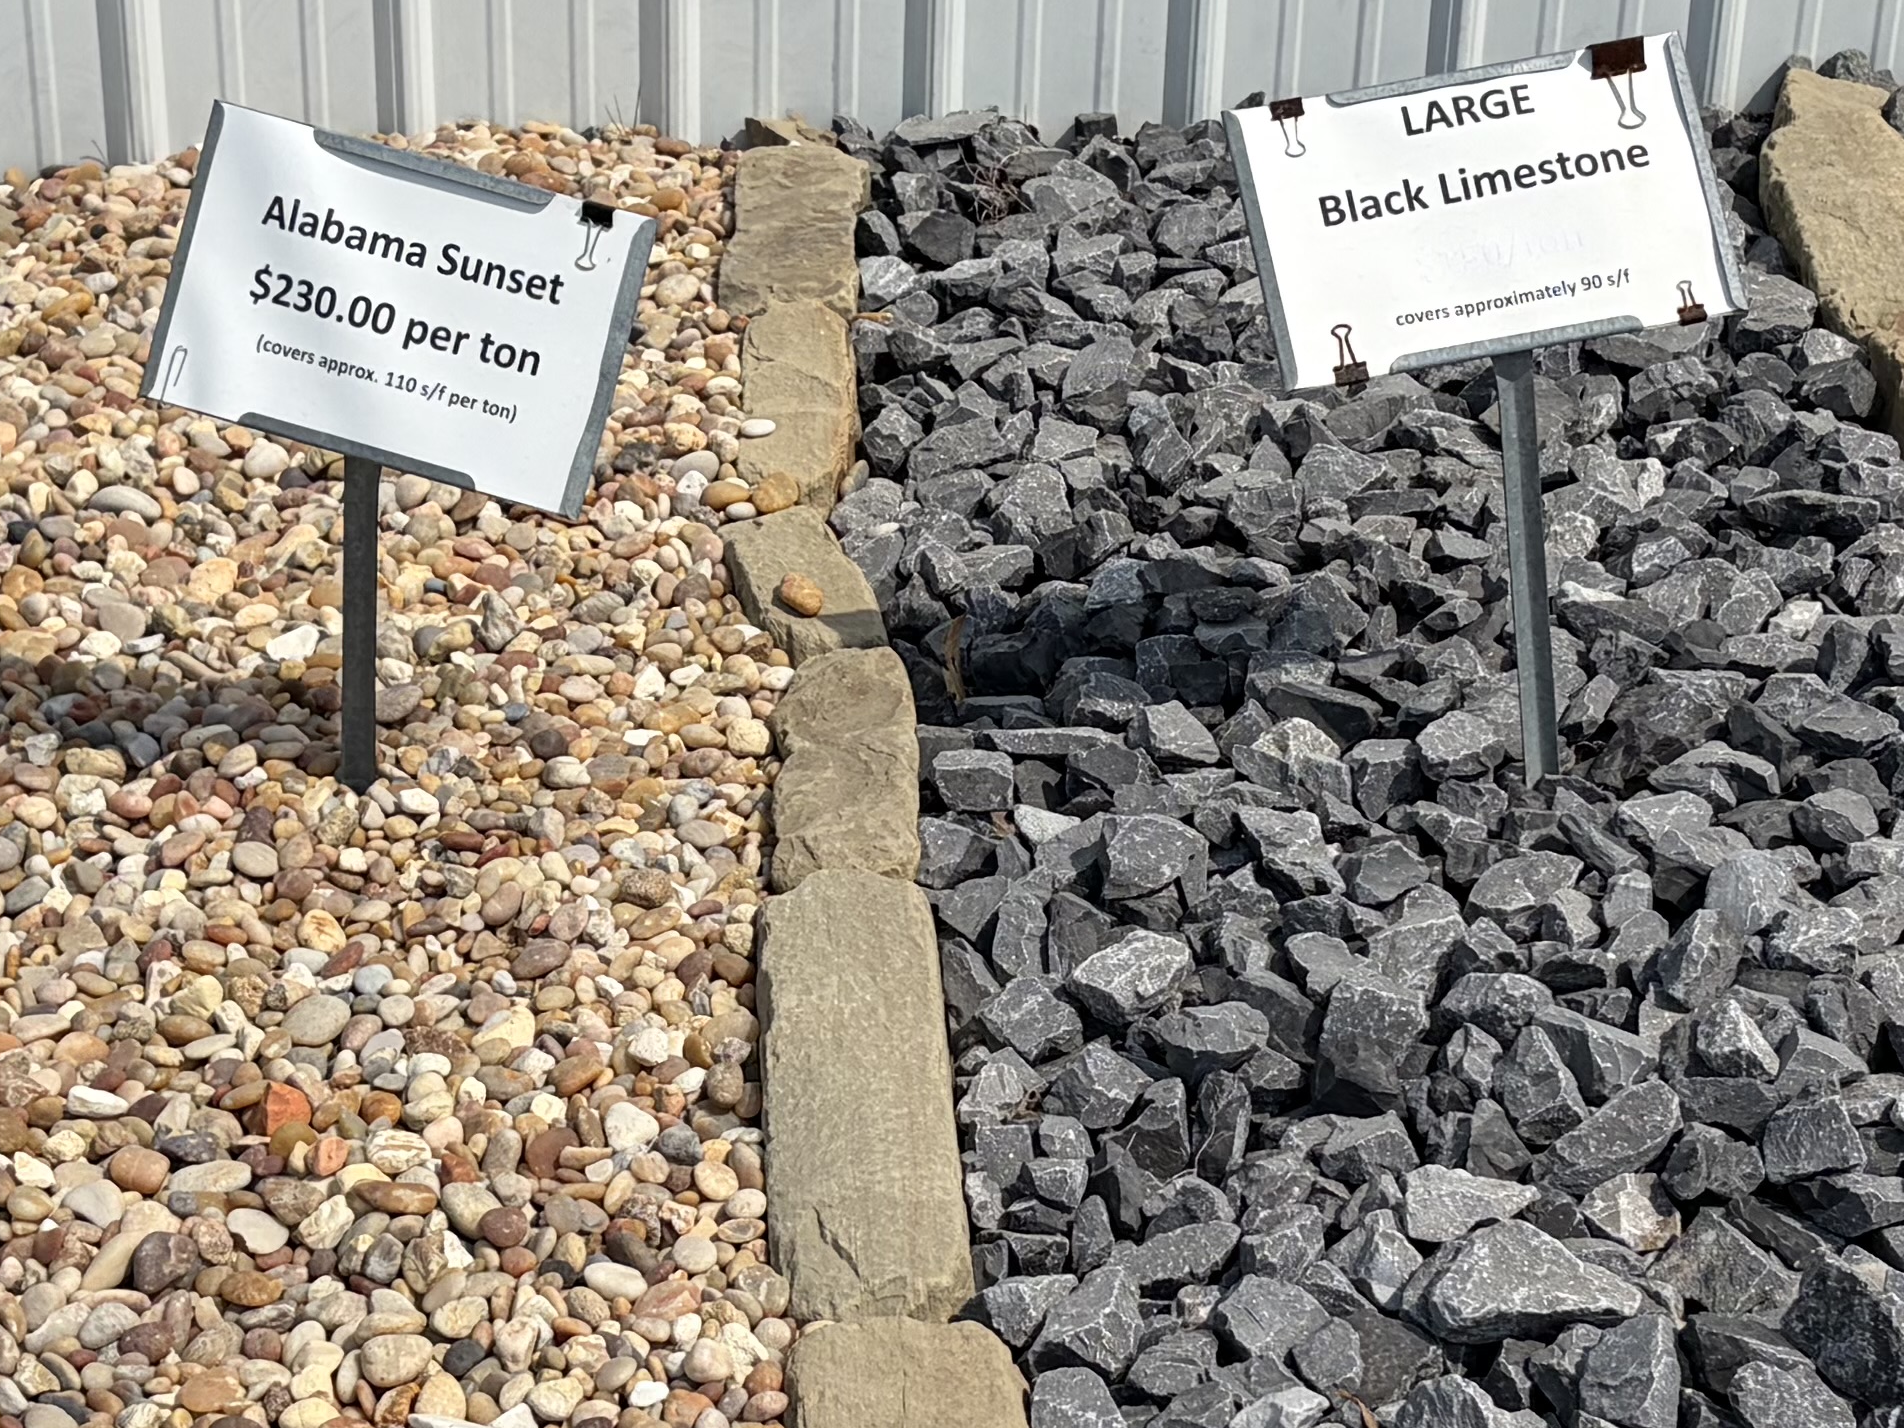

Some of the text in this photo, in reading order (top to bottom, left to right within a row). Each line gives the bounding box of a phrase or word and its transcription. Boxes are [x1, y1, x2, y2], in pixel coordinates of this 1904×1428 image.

[1401, 84, 1535, 136] LARGE
[1318, 145, 1649, 227] Black Limestone
[261, 196, 564, 305] Alabama Sunset
[249, 264, 540, 376] $230.00 per ton
[1396, 268, 1629, 326] covers approximately 90 s/f
[256, 334, 517, 424] (covers approx. 110 s/f per ton)
